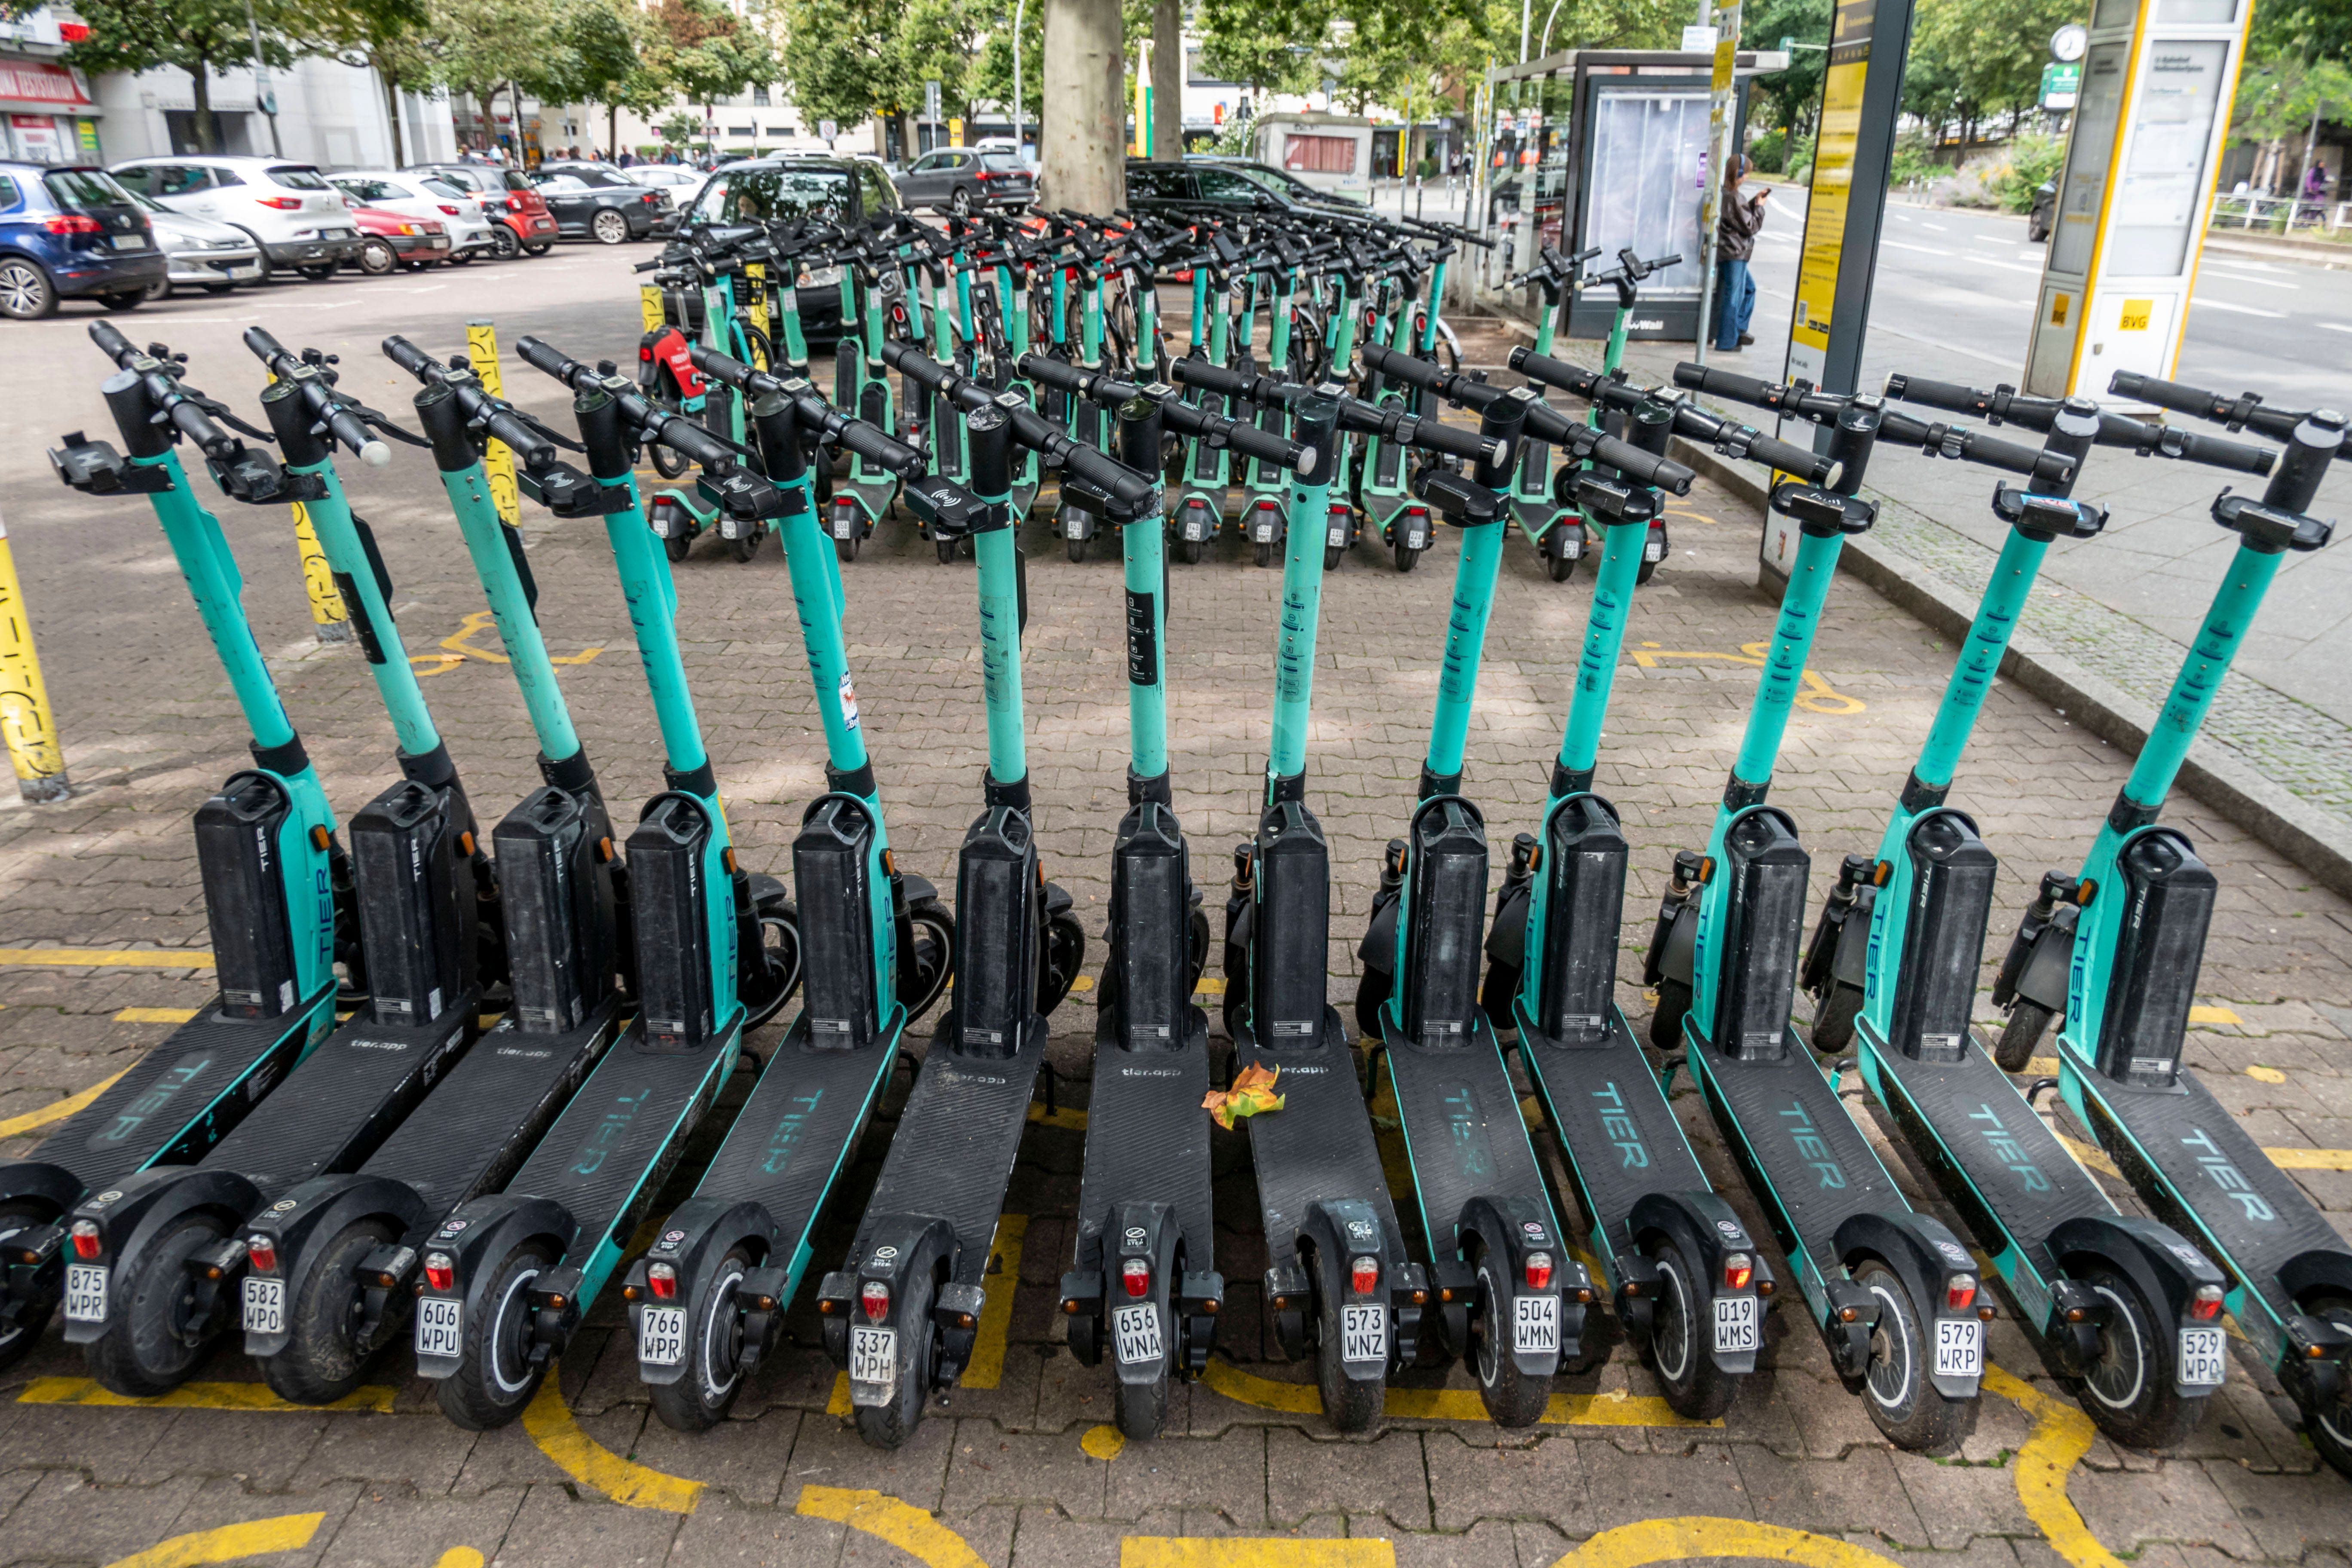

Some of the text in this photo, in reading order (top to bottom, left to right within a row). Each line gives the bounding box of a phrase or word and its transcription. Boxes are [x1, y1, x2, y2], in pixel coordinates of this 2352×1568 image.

[1640, 320, 1664, 331] Wall
[2122, 315, 2147, 328] BVG
[257, 825, 270, 872] TIER
[411, 838, 422, 882] TIER
[554, 838, 564, 884] TIER
[688, 852, 698, 897] TIER
[1736, 863, 1746, 903] TIER
[1919, 867, 1932, 908] TIER
[318, 867, 333, 965] TIER
[2132, 887, 2147, 929] TIER
[727, 894, 736, 994] TIER
[883, 894, 894, 989] TIER
[1525, 888, 1539, 984] TIER
[1693, 903, 1709, 1001] TIER
[1866, 905, 1886, 1001] TIER
[2069, 926, 2091, 1025] TIER
[351, 1039, 408, 1051] tier.app
[1121, 1067, 1181, 1077] tier.app
[97, 1059, 211, 1141] TIER
[570, 1088, 652, 1175] TIER
[759, 1088, 824, 1175] TIER
[1443, 1087, 1487, 1175] TIER
[1591, 1081, 1650, 1169] TIER
[1779, 1101, 1847, 1189] TIER
[1968, 1103, 2050, 1193] TIER
[2181, 1128, 2275, 1222] TIER
[69, 1268, 102, 1291] 875
[69, 1294, 103, 1316] WPR
[247, 1282, 279, 1306] 582
[246, 1306, 279, 1331] WPO
[423, 1303, 456, 1326] 606
[1120, 1308, 1155, 1332] 656
[1346, 1308, 1382, 1331] 573
[1519, 1300, 1553, 1321] 504
[1718, 1300, 1751, 1322] 019
[646, 1313, 680, 1335] 766
[1517, 1325, 1554, 1347] WMN
[1718, 1323, 1753, 1346] WMS
[1941, 1323, 1975, 1344] 579
[421, 1327, 457, 1352] WPU
[644, 1338, 681, 1360] WPR
[856, 1331, 890, 1354] 337
[1122, 1334, 1162, 1359] WNA
[1348, 1334, 1383, 1357] WNZ
[2185, 1333, 2220, 1354] 529
[855, 1355, 892, 1379] WPH
[1939, 1348, 1975, 1370] WRP
